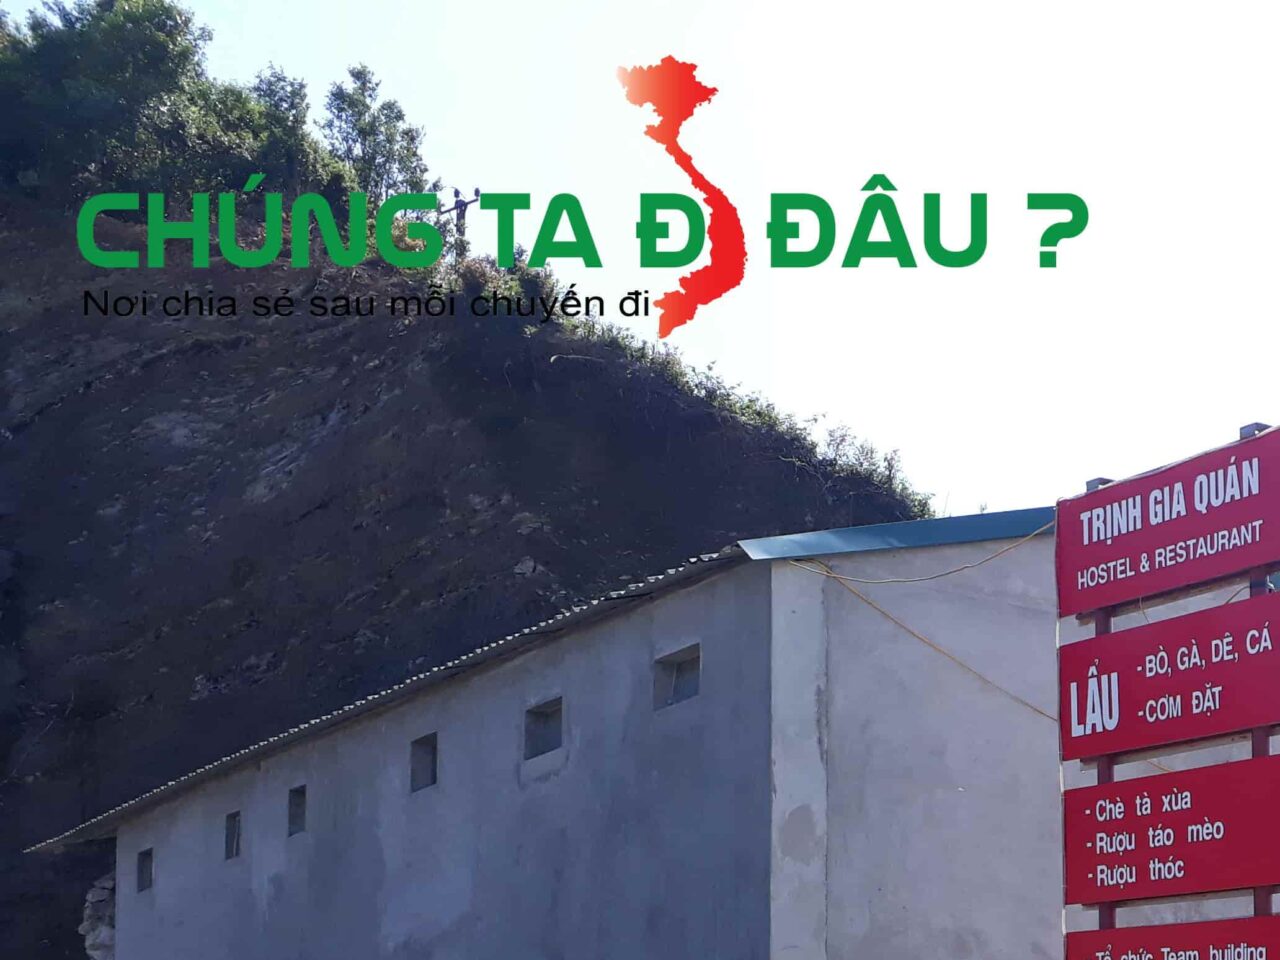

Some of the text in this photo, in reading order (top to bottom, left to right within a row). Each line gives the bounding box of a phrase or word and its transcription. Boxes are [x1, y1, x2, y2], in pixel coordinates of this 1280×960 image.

[1080, 455, 1260, 546] TRỊNH GIA QUÁN
[1077, 519, 1264, 591] HOSTEL & RESTAURANT
[1246, 621, 1273, 655] CÁ
[1070, 658, 1120, 738] LẨU
[1192, 682, 1223, 717] ĐẶT
[1135, 791, 1152, 817] tà
[1161, 787, 1192, 813] xùa
[1148, 823, 1175, 848] táo
[1187, 816, 1224, 843] mèo
[1149, 856, 1185, 881] thóc
